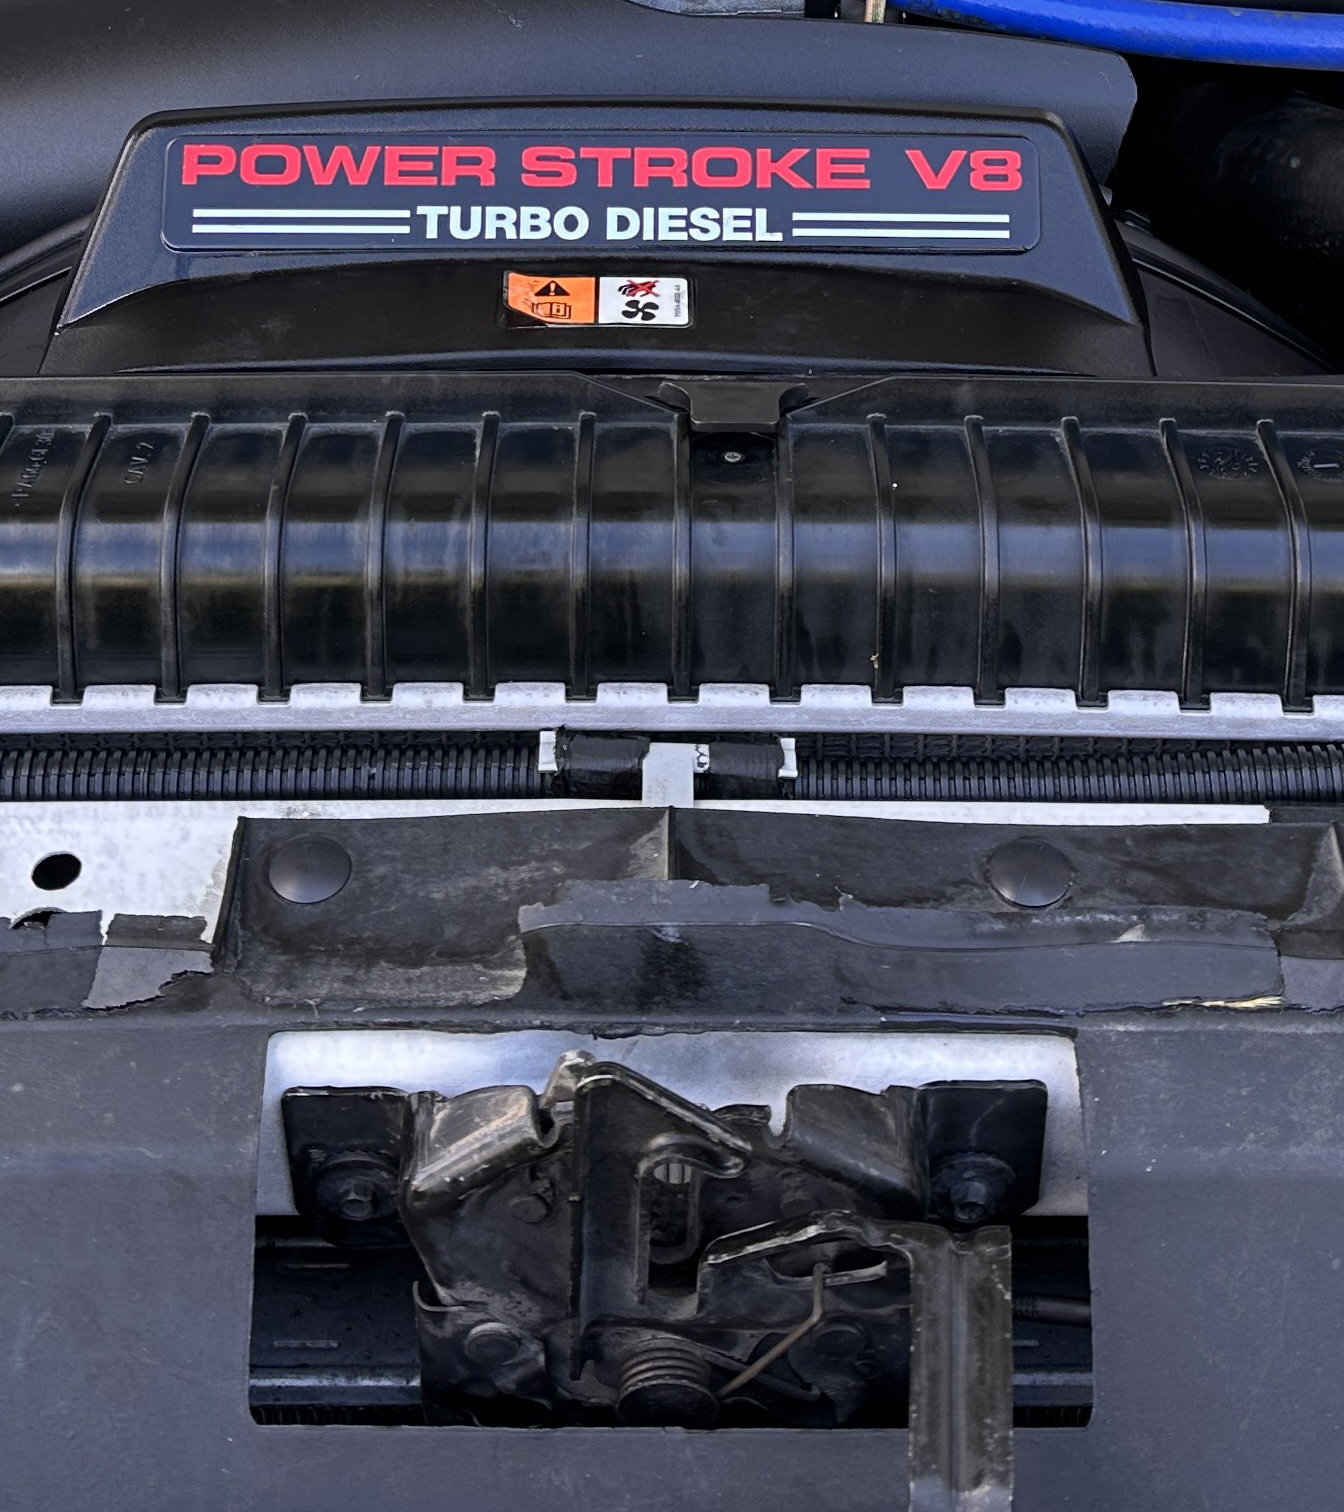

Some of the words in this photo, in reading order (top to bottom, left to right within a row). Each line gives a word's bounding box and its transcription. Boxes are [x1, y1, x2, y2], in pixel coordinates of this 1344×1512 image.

[182, 143, 495, 186] POWER
[521, 145, 869, 190] STROKE
[907, 149, 1022, 192] V8
[416, 205, 590, 241] TURBO
[605, 207, 783, 242] DIESEL
